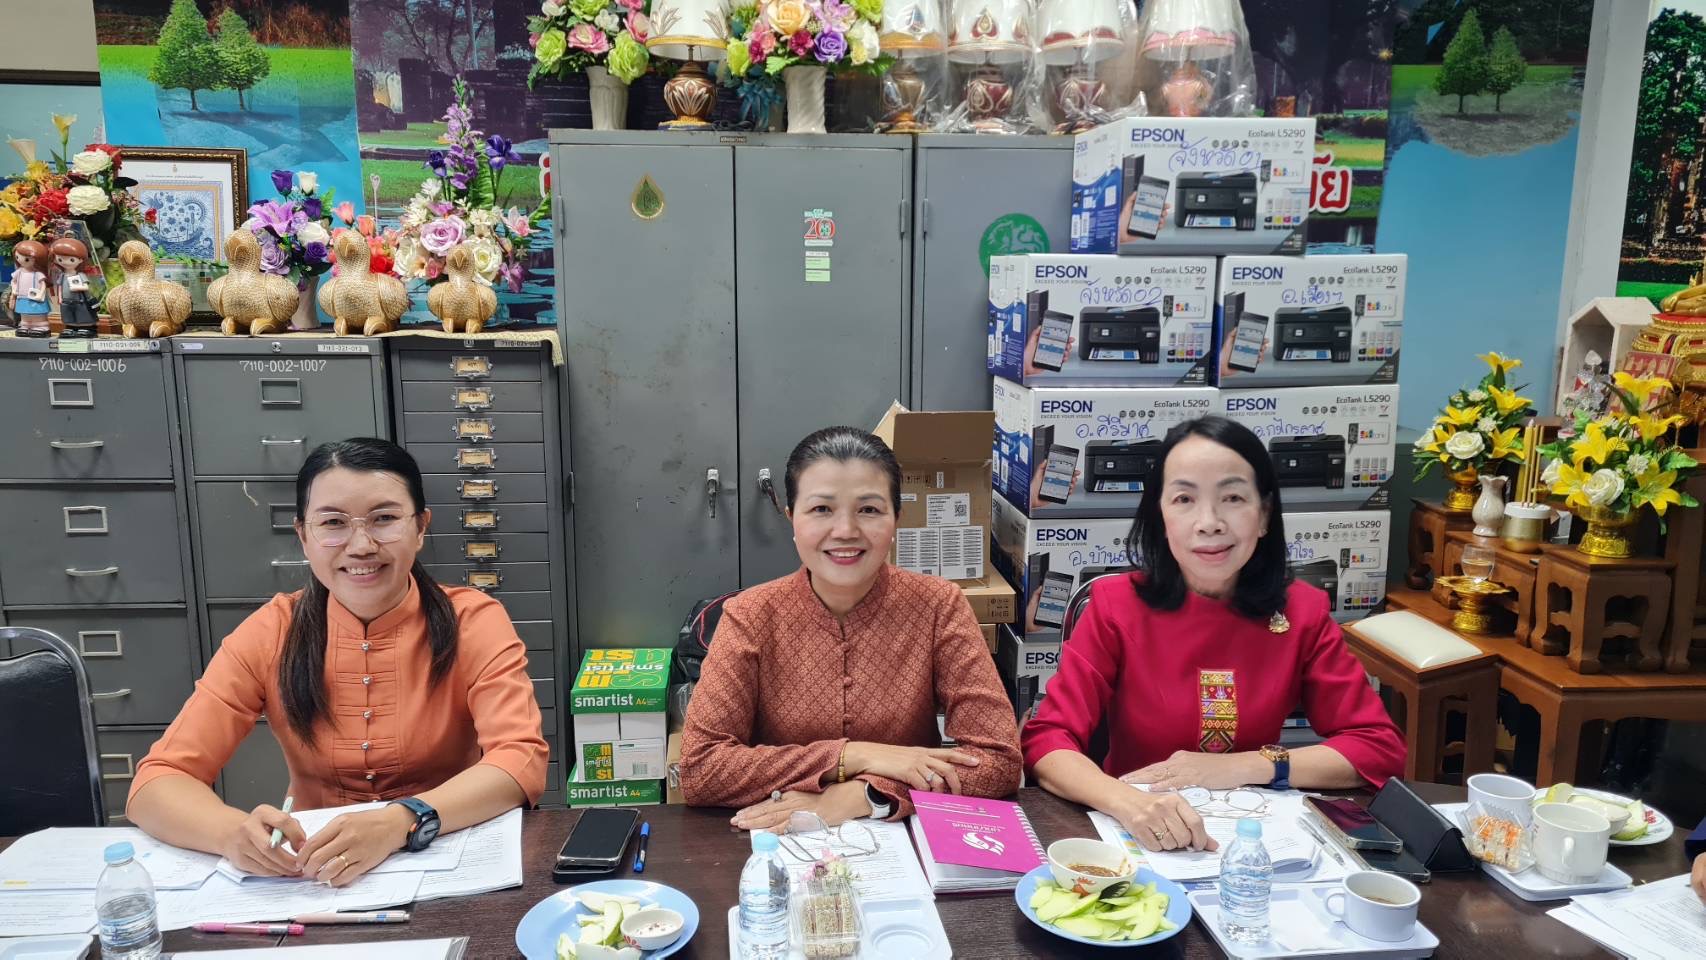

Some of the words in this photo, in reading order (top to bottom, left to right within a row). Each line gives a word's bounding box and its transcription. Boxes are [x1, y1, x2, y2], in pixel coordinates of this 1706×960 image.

[1131, 128, 1184, 142] EPSON
[1277, 129, 1306, 138] L5290
[1035, 265, 1088, 278] EPSON
[1150, 266, 1176, 274] EcoTank
[1179, 266, 1207, 274] L5290
[1232, 266, 1283, 280] EPSON
[1343, 266, 1369, 274] EcoTank
[1371, 265, 1397, 274] L5290
[39, 357, 127, 373] 7110-002-1006
[239, 359, 327, 372] 7110-002-1007
[1154, 400, 1180, 408] EcoTank
[1182, 399, 1210, 408] L5290
[1226, 397, 1277, 411] EPSON
[1336, 396, 1361, 404] EcoTank
[1364, 395, 1391, 403] L5290
[1041, 400, 1093, 413] EPSON
[1328, 522, 1354, 530] EcoTank
[1355, 520, 1382, 529] L5290
[1036, 528, 1087, 541] EPSON
[574, 693, 634, 708] smartist
[570, 785, 628, 799] smartist
